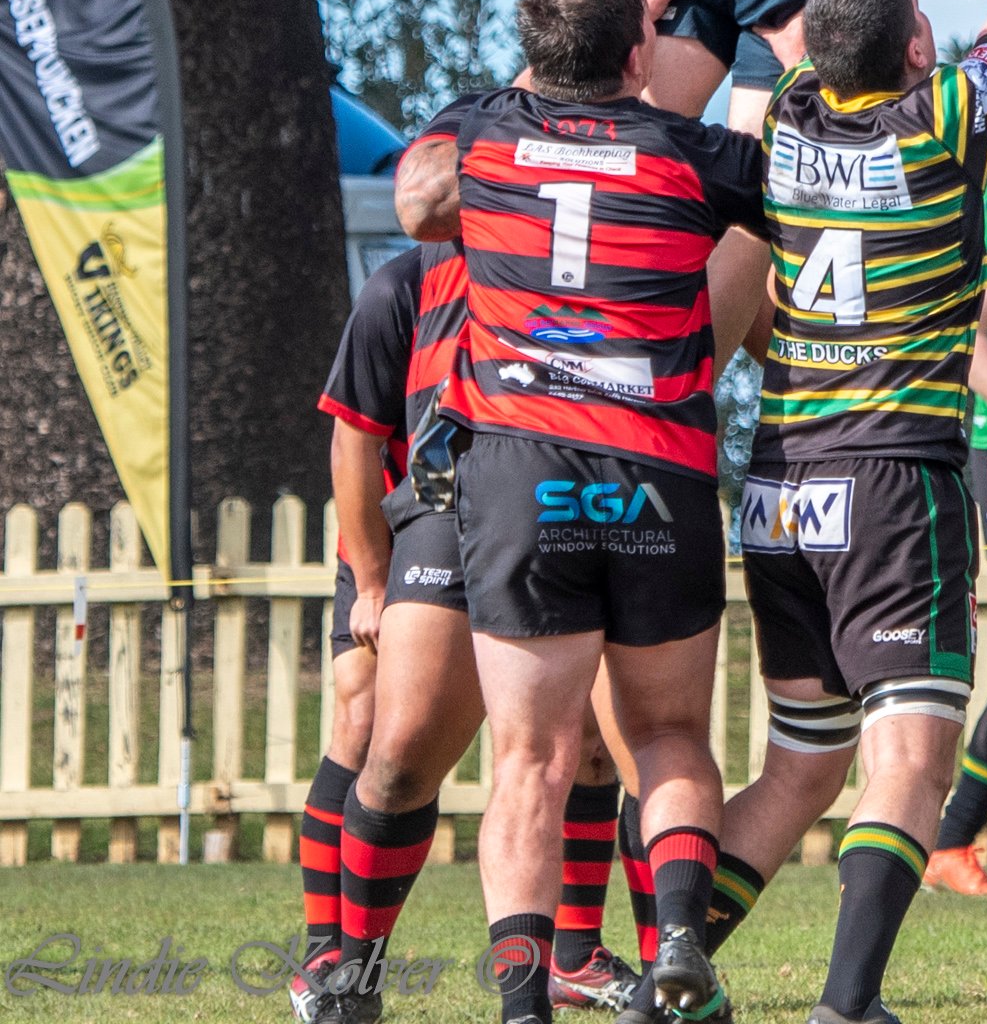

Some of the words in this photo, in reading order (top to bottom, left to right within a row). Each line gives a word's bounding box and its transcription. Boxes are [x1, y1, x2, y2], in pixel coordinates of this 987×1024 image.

[542, 119, 618, 141] 1973
[792, 188, 817, 204] Blue
[819, 192, 857, 209] Water
[862, 196, 902, 211] Legal
[538, 182, 595, 289] 1
[791, 228, 866, 325] 4
[778, 339, 808, 361] THE
[811, 343, 888, 365] DUCKS
[535, 480, 674, 524] SGA
[538, 528, 676, 544] ARCHITECTURAL
[538, 541, 598, 553] WINDOW
[872, 629, 926, 642] GOOSEY
